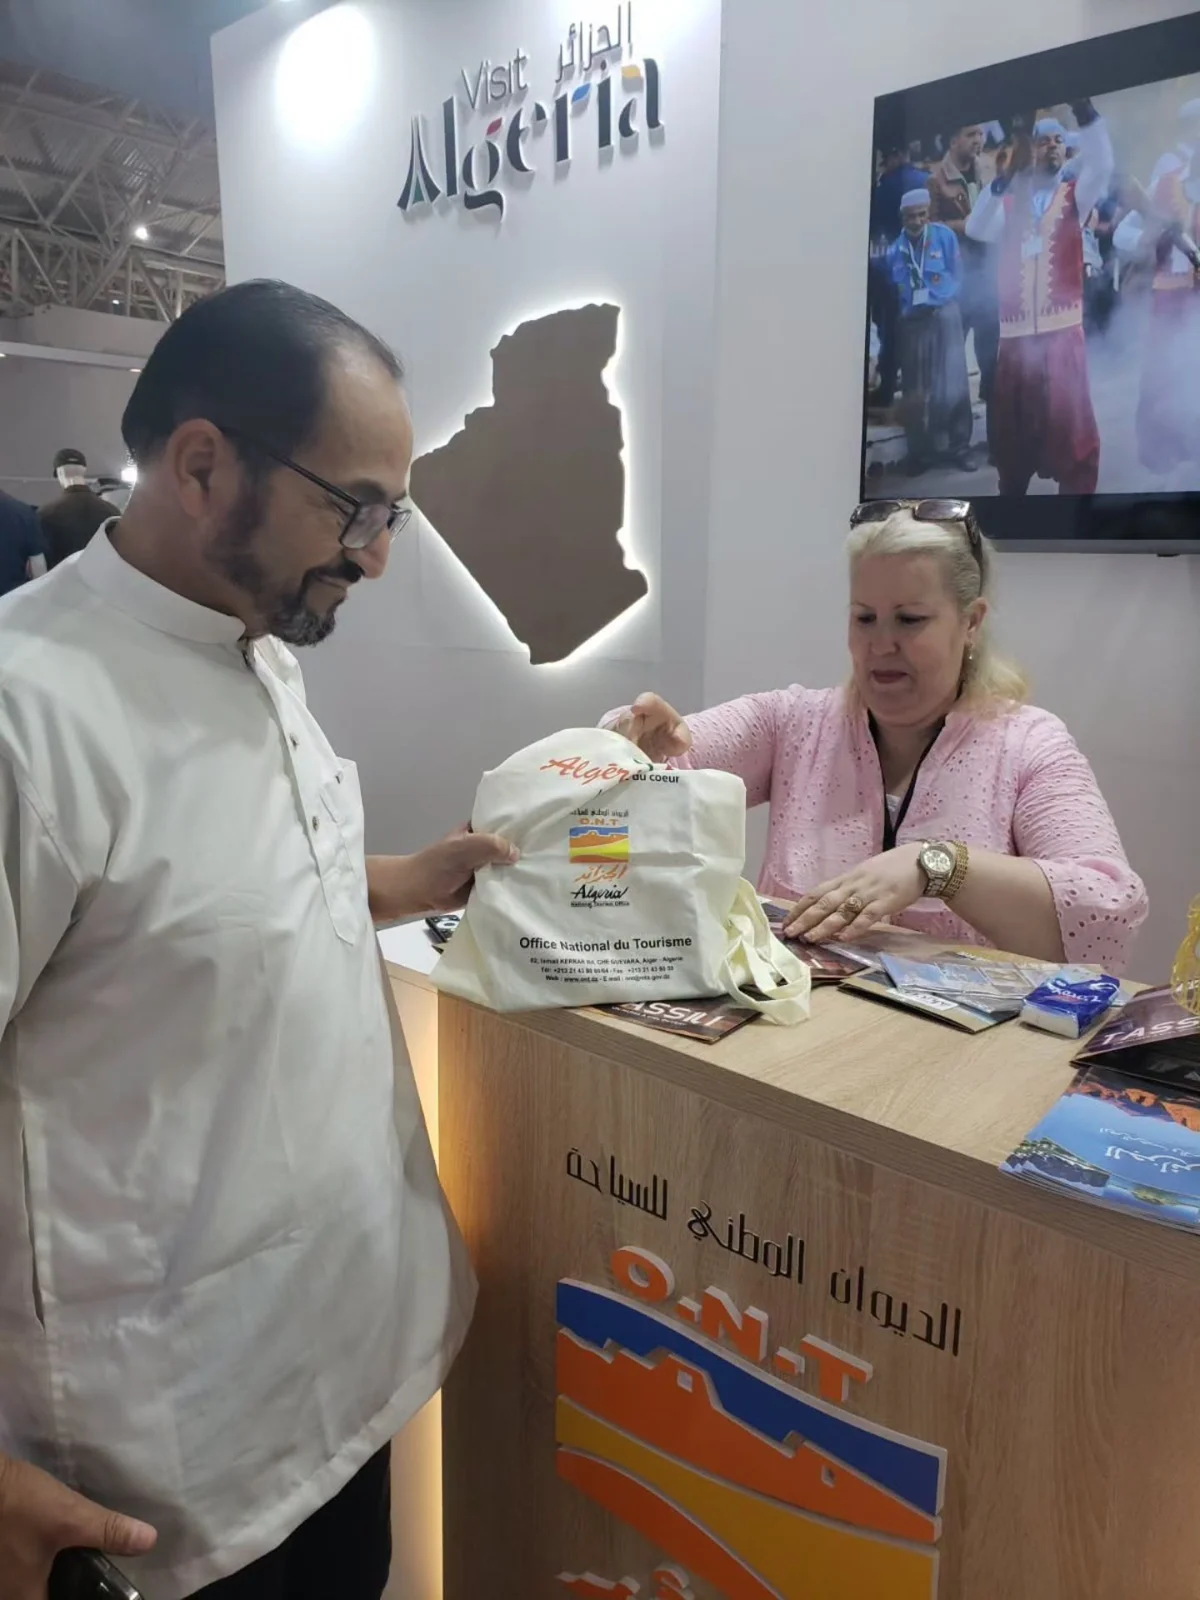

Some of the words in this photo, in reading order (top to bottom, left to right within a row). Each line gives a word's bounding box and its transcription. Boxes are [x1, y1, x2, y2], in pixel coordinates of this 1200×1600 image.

[555, 1, 631, 84] الجزائر
[461, 47, 529, 110] Visit
[396, 57, 661, 222] Algeria
[649, 773, 680, 783] coeur
[570, 884, 630, 903] Algeria
[519, 936, 558, 949] Office
[560, 939, 610, 952] National
[613, 939, 630, 950] du
[632, 937, 693, 950] Tourisme
[619, 1001, 725, 1027] ASSILI
[566, 1147, 668, 1221] للسياحة
[686, 1200, 805, 1285] الوطني
[830, 1265, 962, 1357] الديوان
